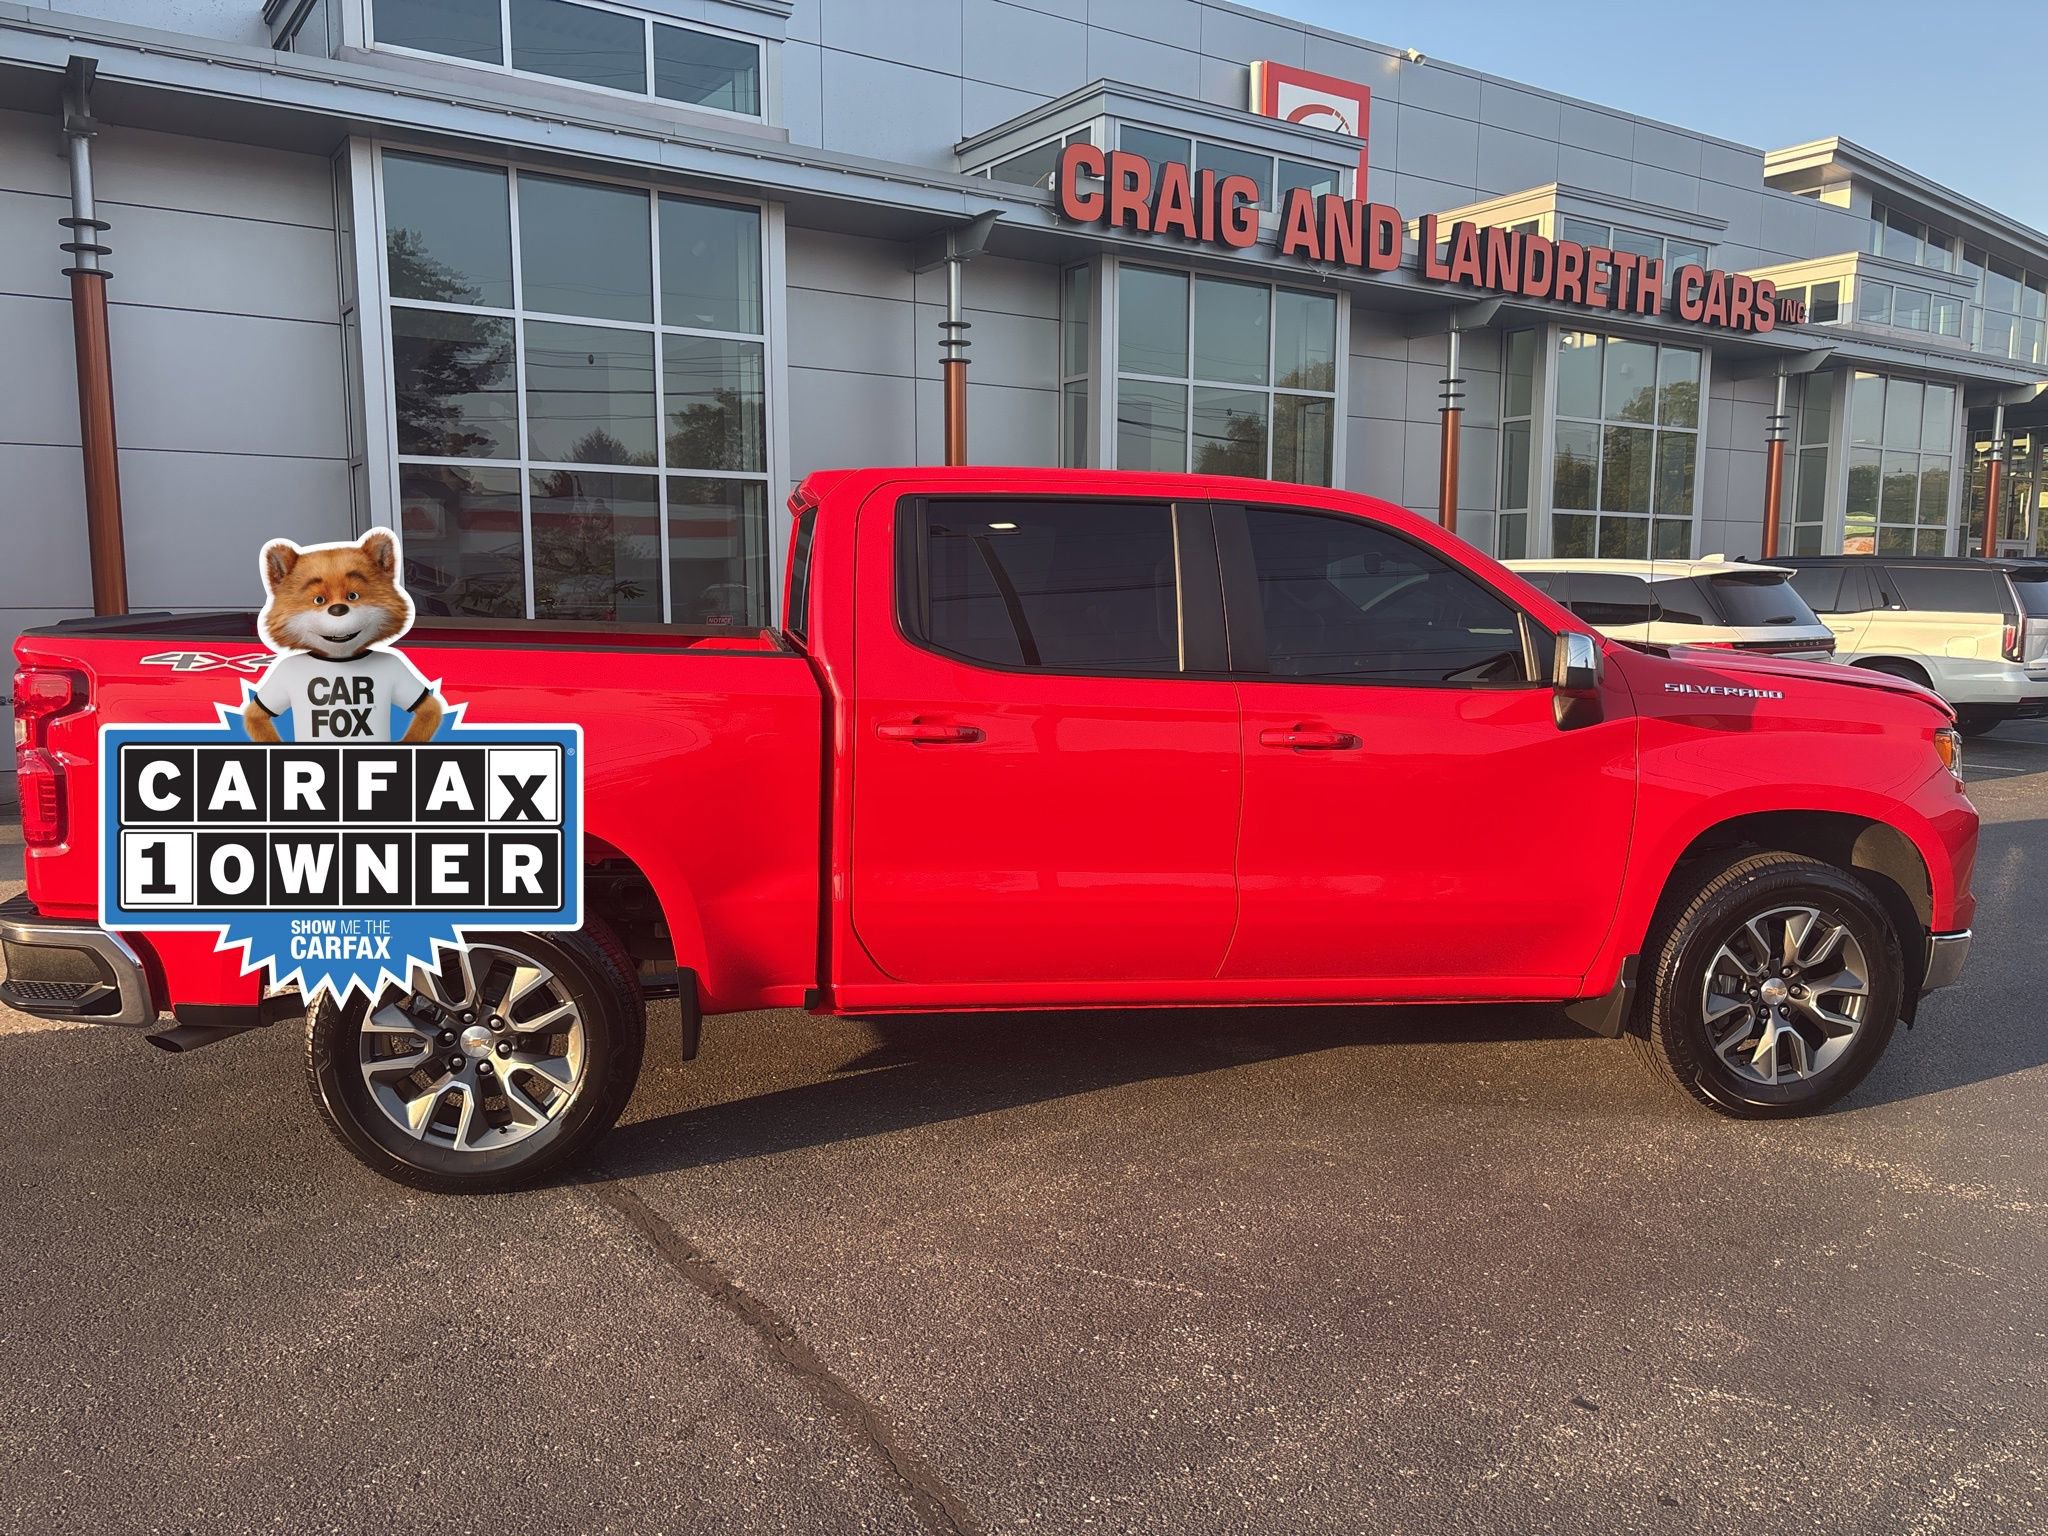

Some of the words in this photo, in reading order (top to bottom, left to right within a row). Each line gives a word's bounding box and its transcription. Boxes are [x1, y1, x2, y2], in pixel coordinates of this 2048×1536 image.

[1056, 143, 1259, 248] CRAIG
[1279, 187, 1402, 271] AND
[1420, 214, 1664, 316] LANDRETH
[1673, 264, 1776, 333] CARS
[1665, 683, 1784, 699] SILVERADO
